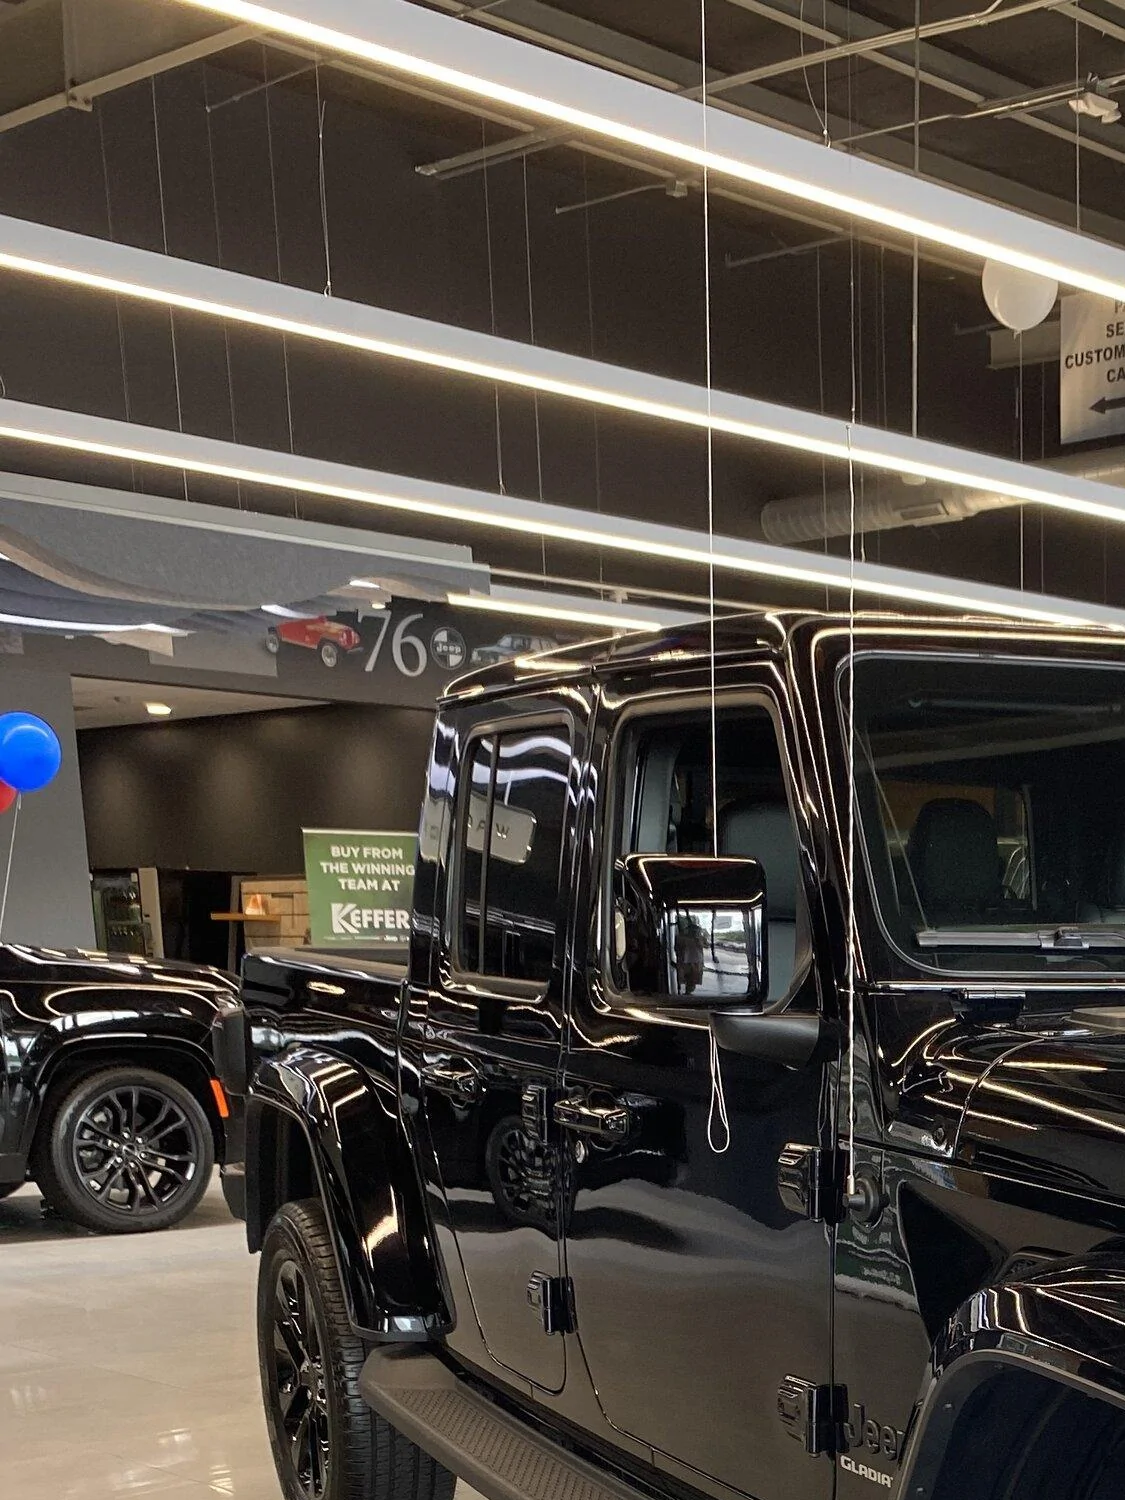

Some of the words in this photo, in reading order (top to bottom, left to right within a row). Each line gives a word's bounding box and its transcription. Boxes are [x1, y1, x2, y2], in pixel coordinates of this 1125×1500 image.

[357, 610, 428, 678] 76
[436, 641, 462, 654] Jeep
[330, 845, 360, 858] BUY
[363, 846, 403, 860] FROM
[320, 861, 348, 874] THE
[351, 863, 416, 876] WINNING
[338, 878, 379, 891] TEAM
[381, 879, 401, 891] AT
[330, 902, 411, 934] KEFFER
[840, 1454, 894, 1488] GLADIA
